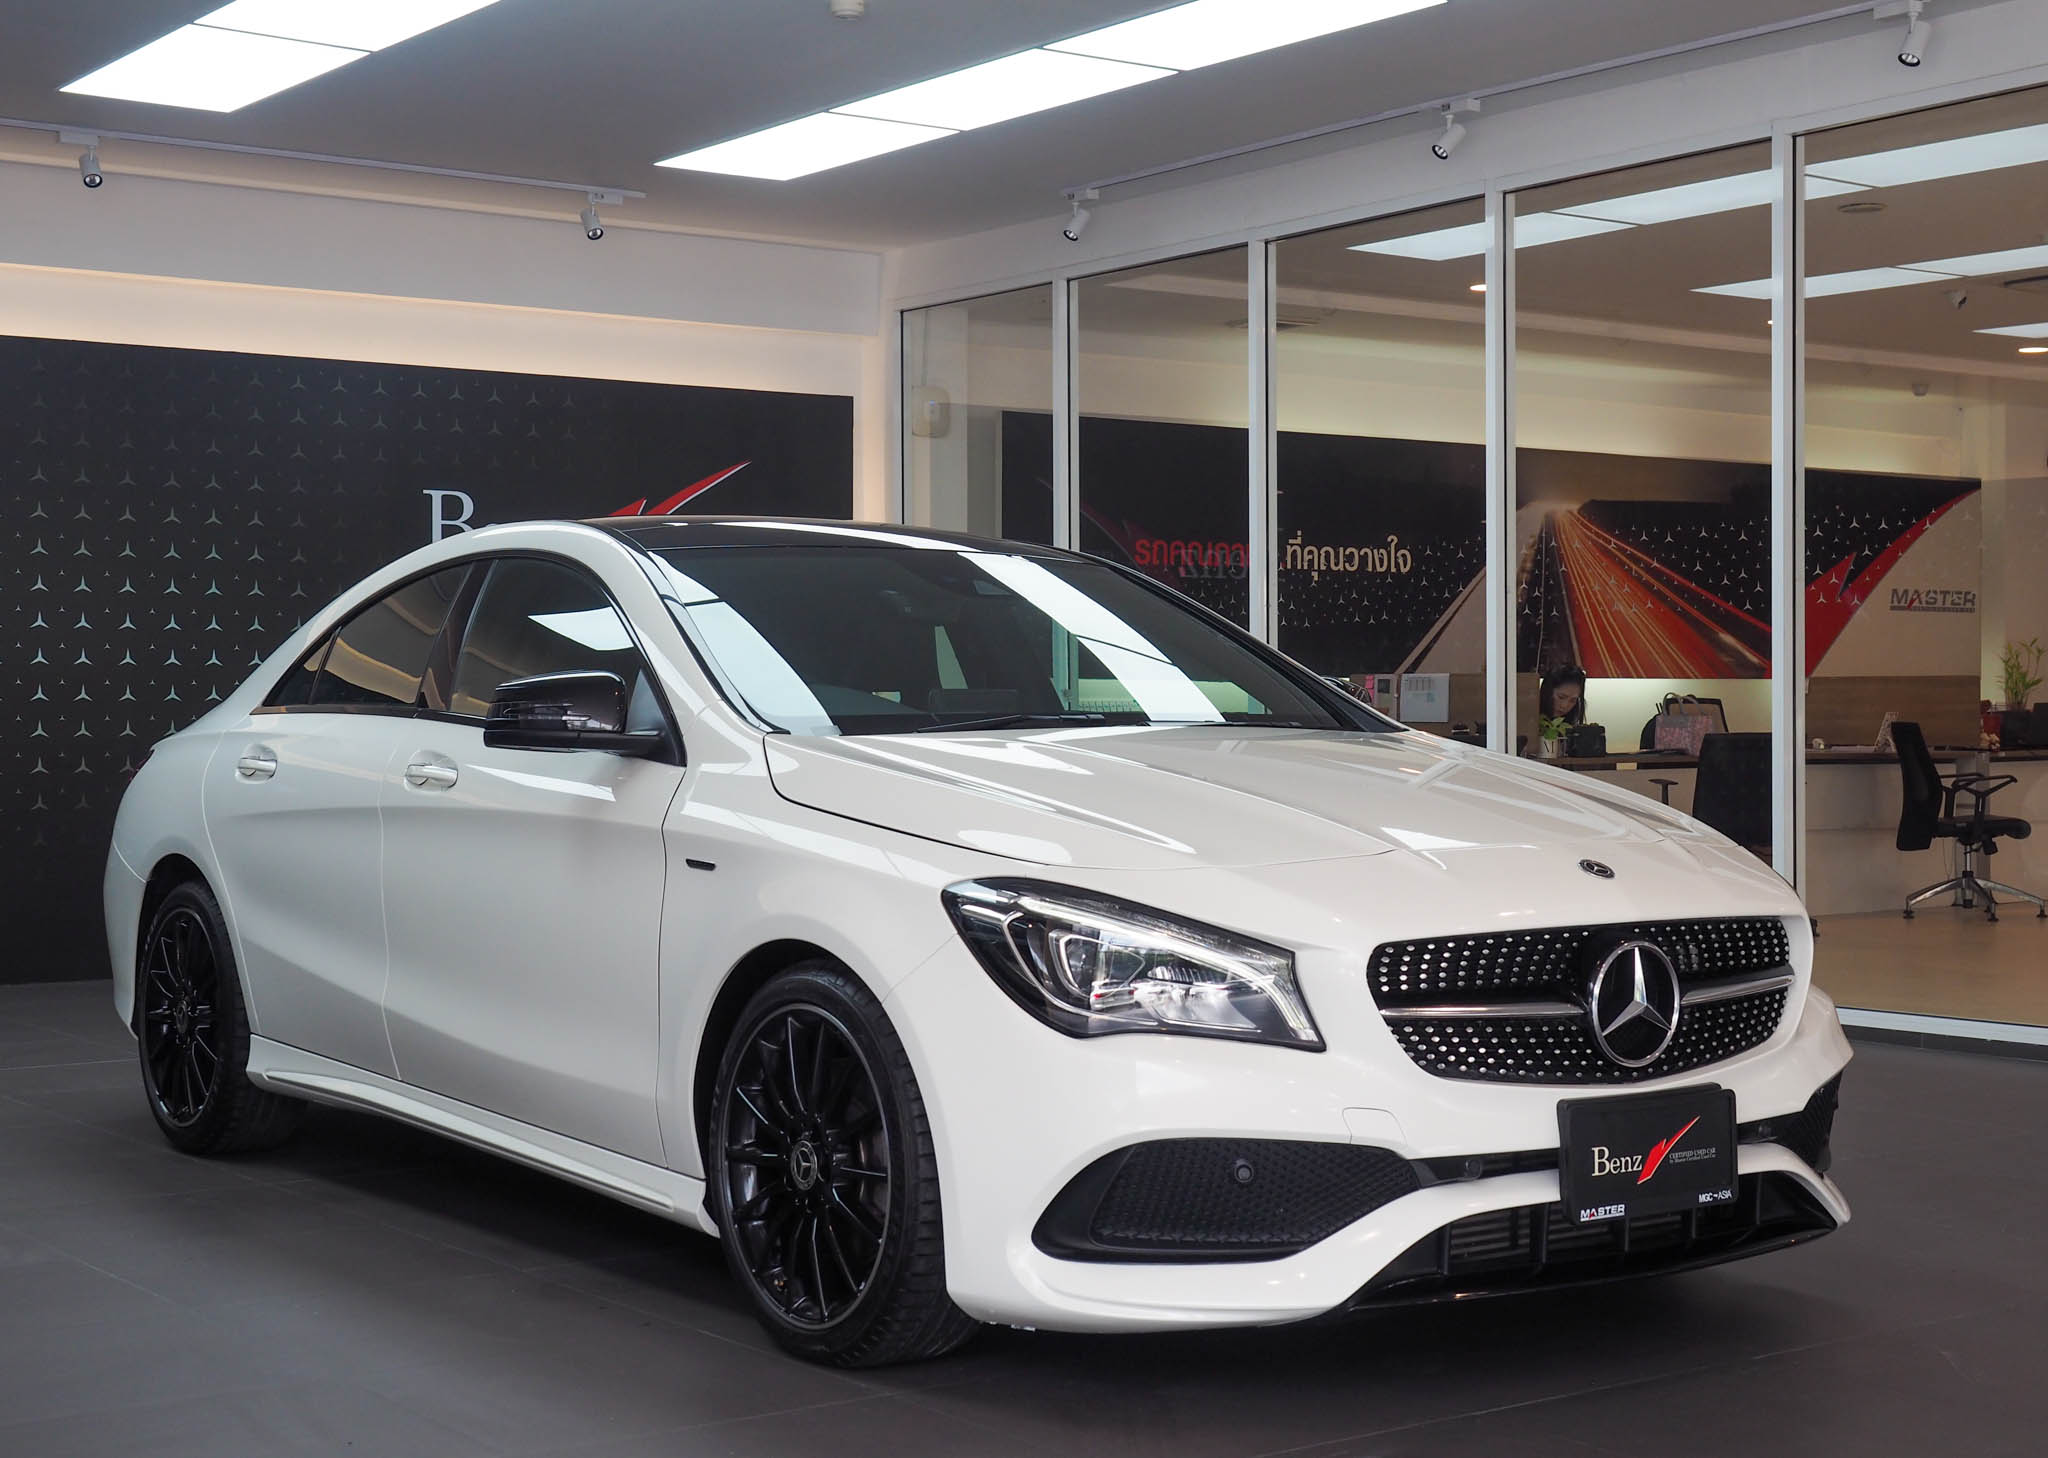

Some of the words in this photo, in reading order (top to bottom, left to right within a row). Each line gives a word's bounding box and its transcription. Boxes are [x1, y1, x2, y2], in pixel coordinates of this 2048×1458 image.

[1286, 529, 1413, 582] ที่คุณวางใจ
[1890, 588, 1977, 607] MASTER
[1591, 1146, 1643, 1177] Benz
[1580, 1204, 1625, 1220] MASTER
